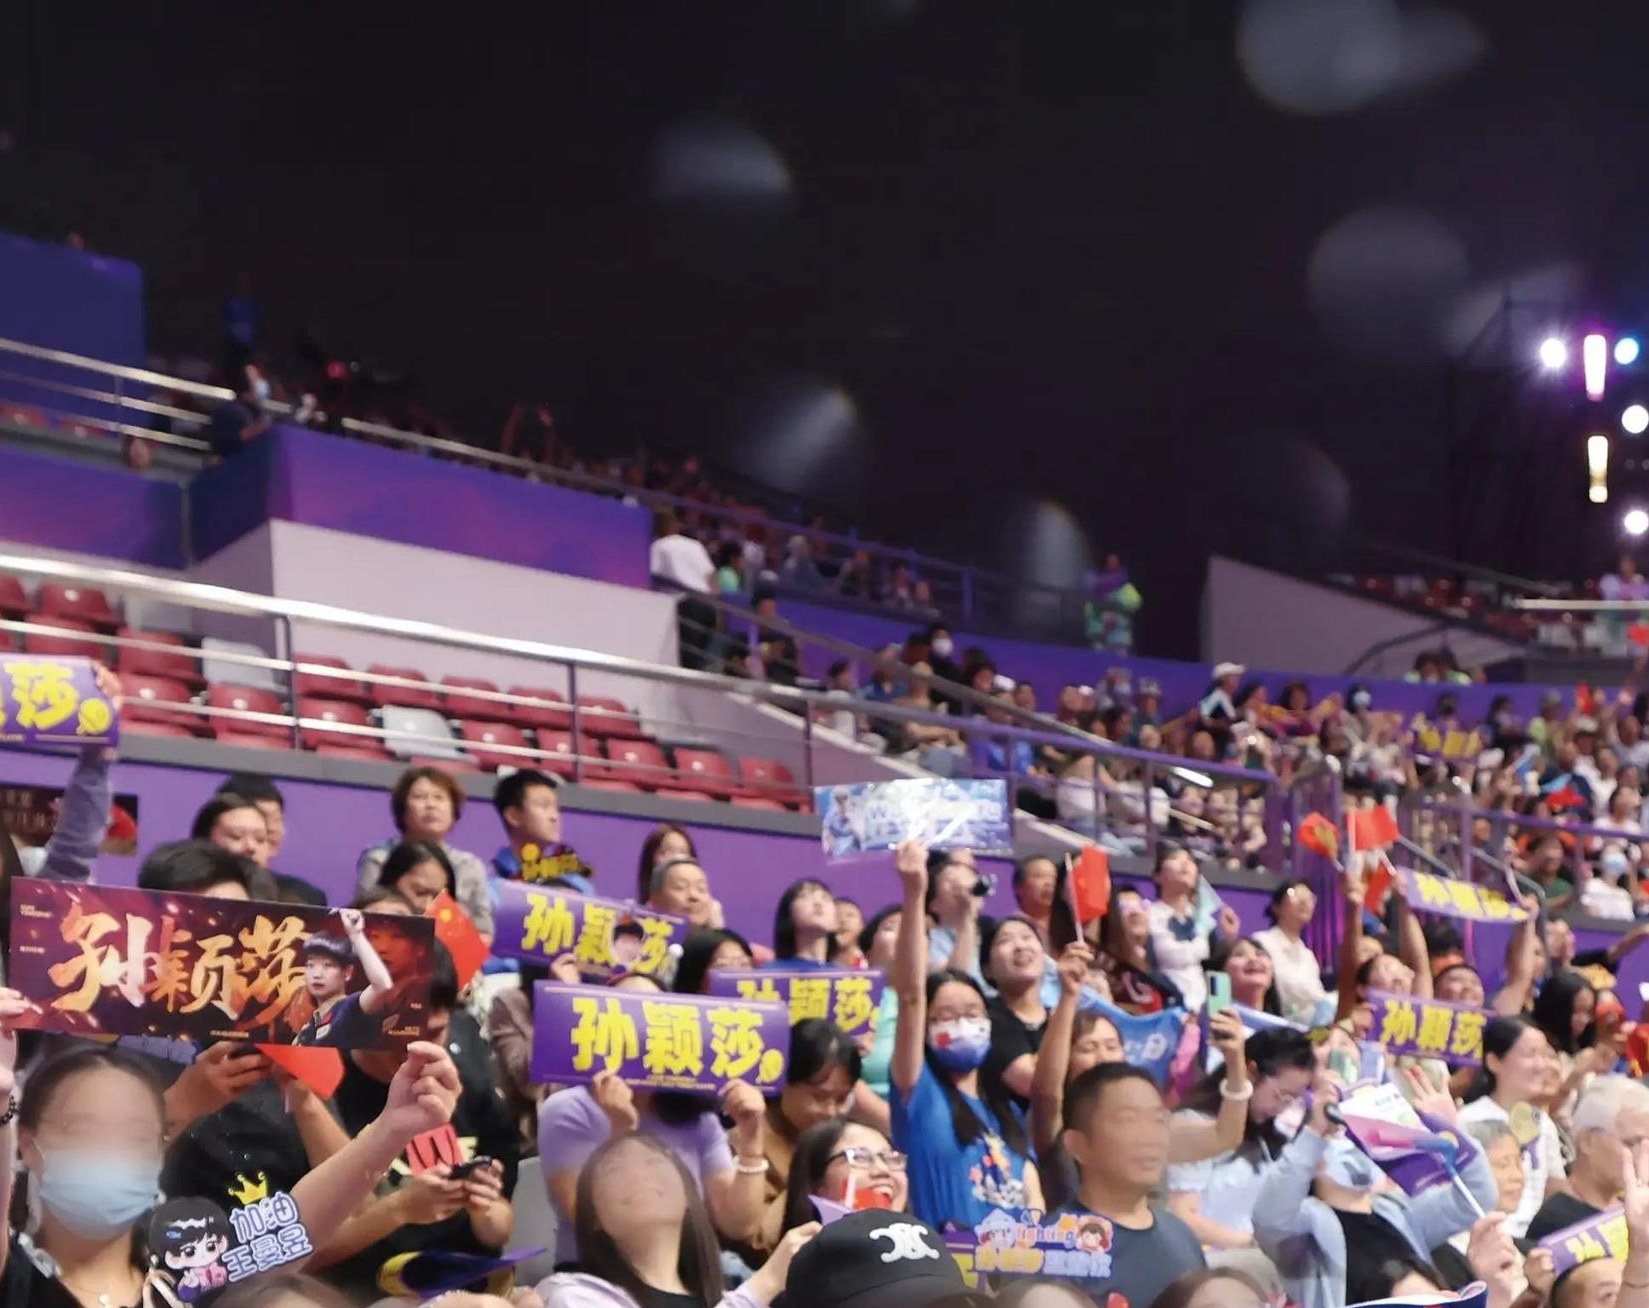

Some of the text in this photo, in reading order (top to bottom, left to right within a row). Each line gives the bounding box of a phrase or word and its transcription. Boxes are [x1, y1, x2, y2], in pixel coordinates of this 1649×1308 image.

[571, 998, 765, 1079] 孙颖莎
[229, 1190, 300, 1245] 加油
[221, 1223, 314, 1283] 王曼昱
